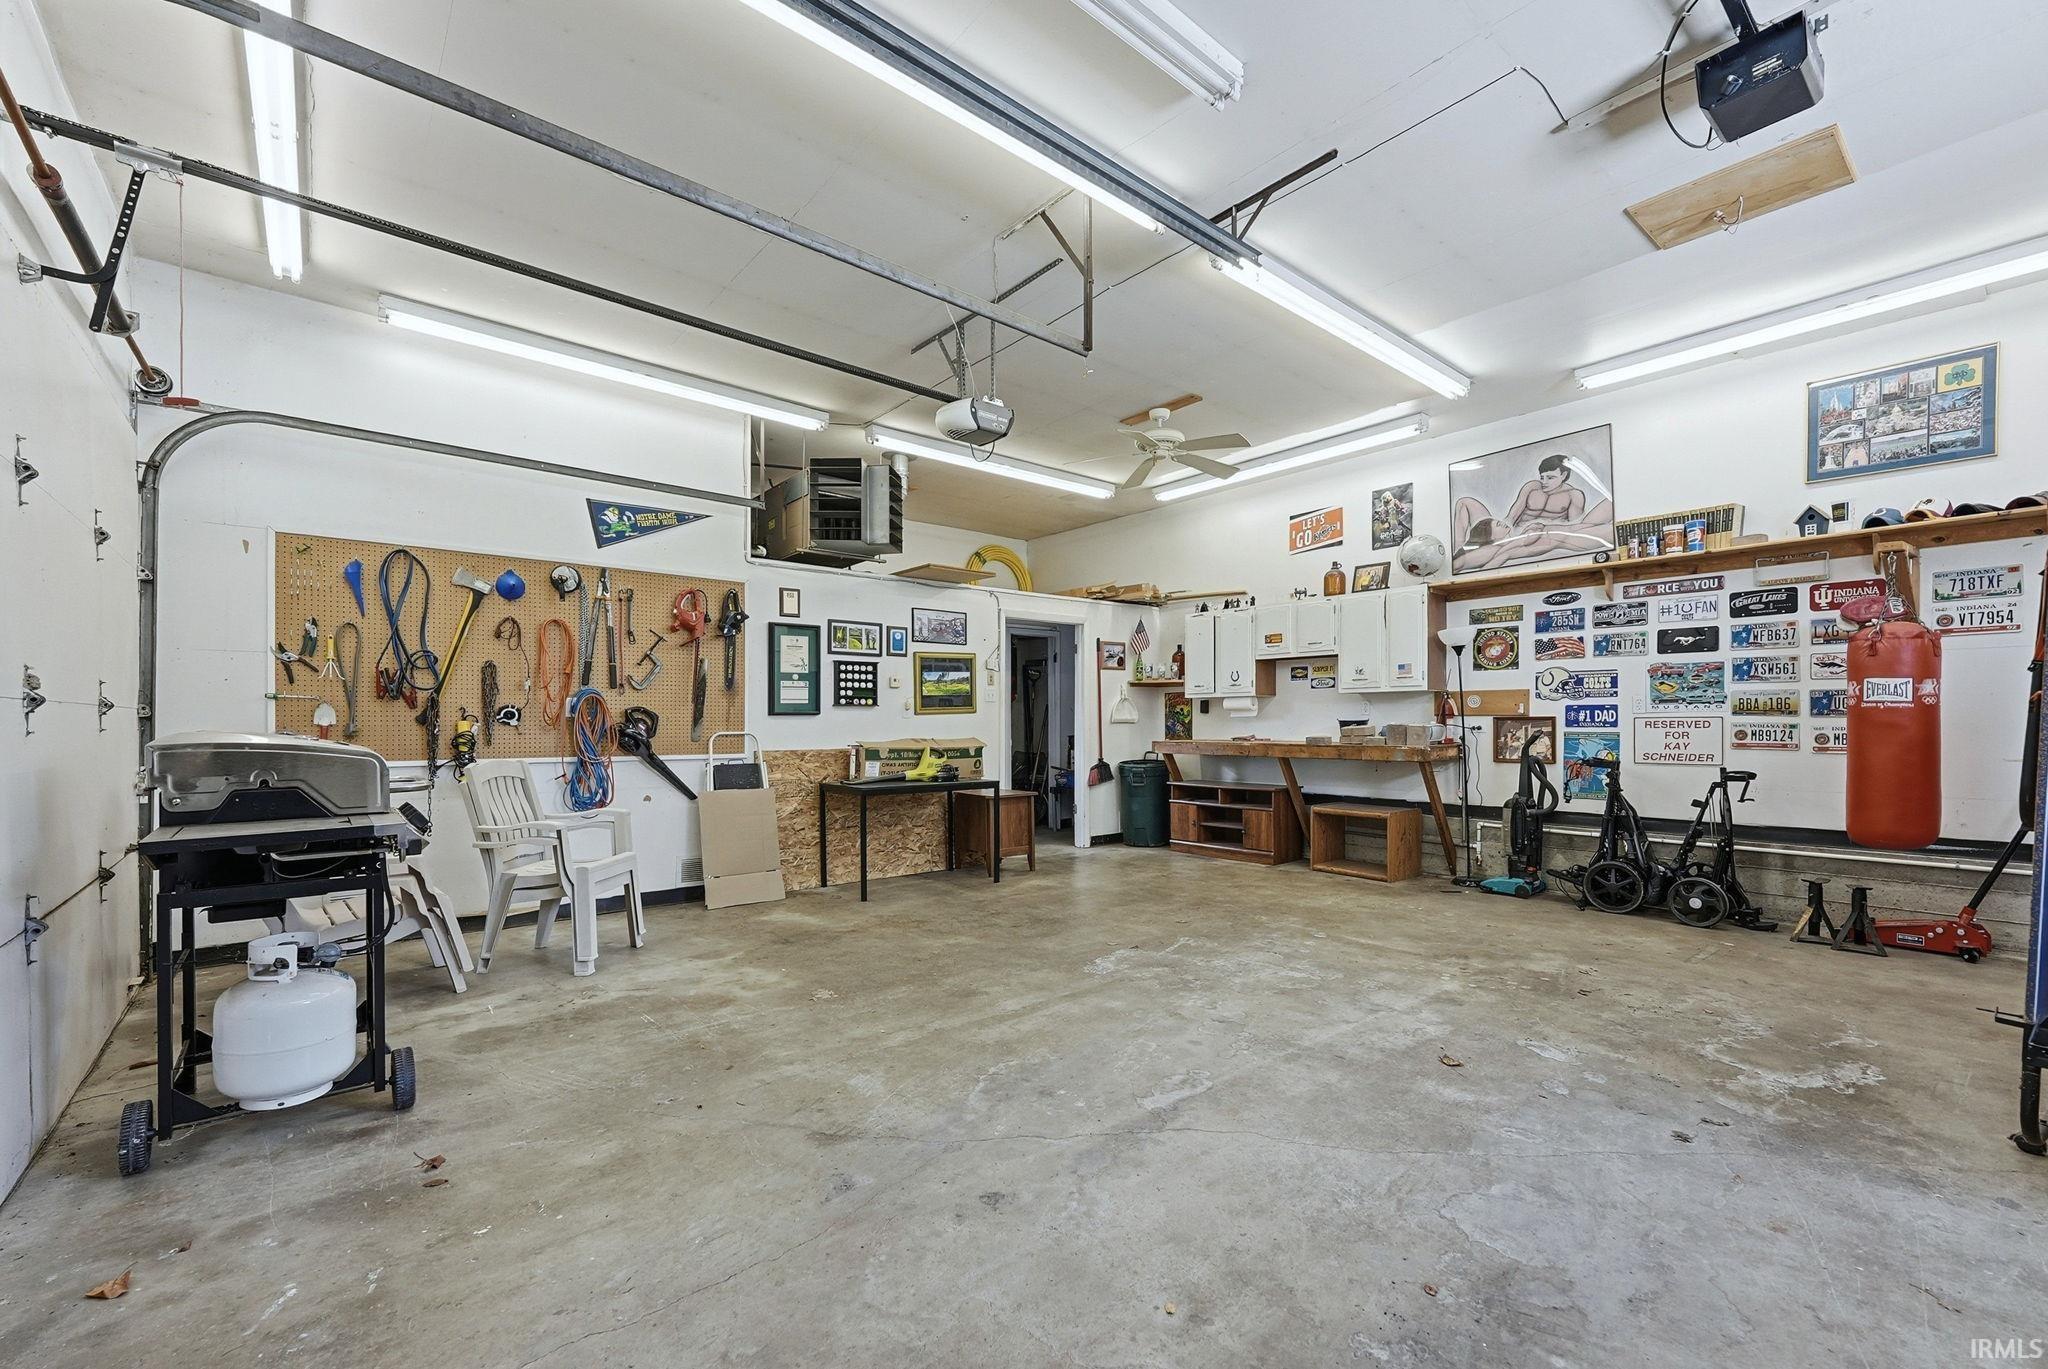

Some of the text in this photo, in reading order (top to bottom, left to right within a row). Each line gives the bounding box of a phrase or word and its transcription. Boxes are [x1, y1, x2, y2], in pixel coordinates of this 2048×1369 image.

[1302, 514, 1325, 530] LET'S
[1296, 530, 1312, 548] GO
[1956, 568, 1997, 577] INDIANA
[1693, 578, 1719, 590] YOU
[1949, 574, 2005, 593] 718TXF
[1834, 586, 1880, 597] INDIANA
[1694, 600, 1717, 614] FAN
[1959, 609, 2014, 627] VT7954
[1583, 676, 1612, 689] COLTS
[1866, 680, 1911, 700] EVERLAST
[1579, 709, 1617, 722] #1 DAD
[1644, 720, 1711, 729] RESERVED
[1664, 731, 1690, 740] FOR
[1750, 729, 1794, 742] MB9124
[1663, 742, 1691, 750] KAY
[1642, 752, 1715, 762] SCHNEIDER
